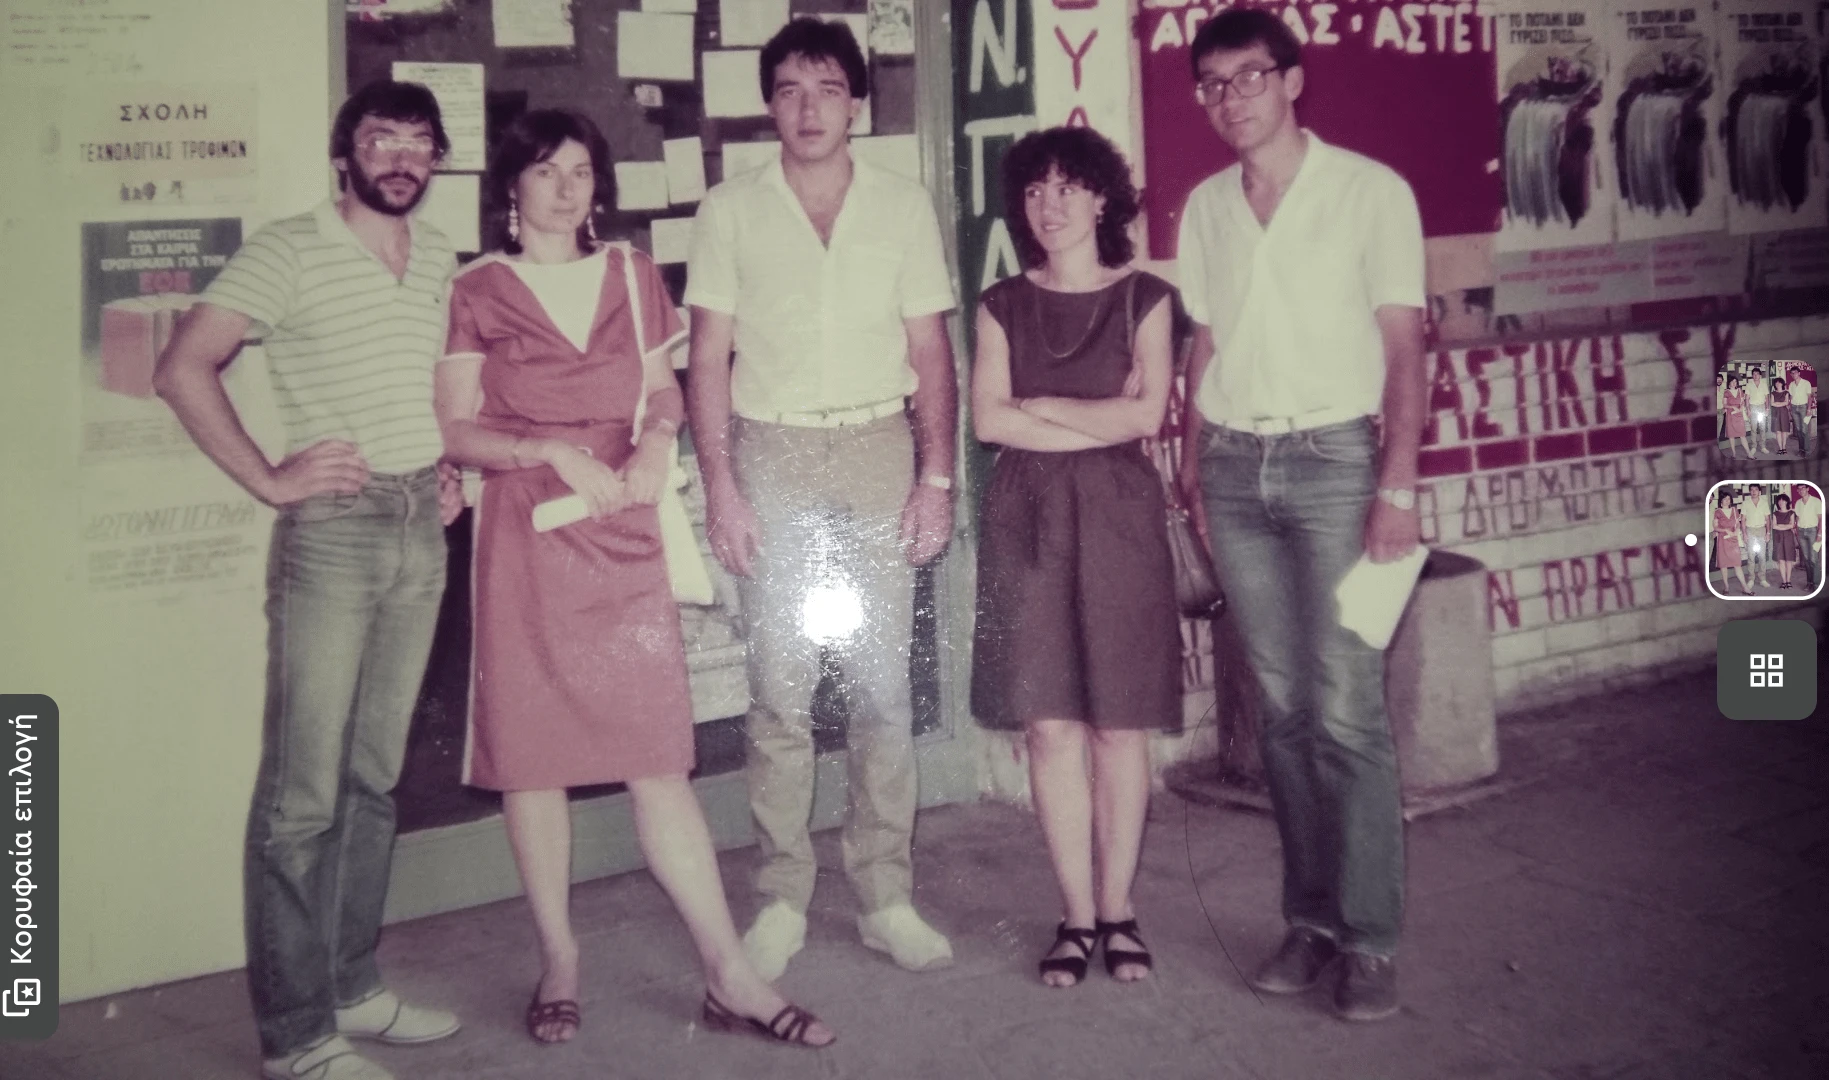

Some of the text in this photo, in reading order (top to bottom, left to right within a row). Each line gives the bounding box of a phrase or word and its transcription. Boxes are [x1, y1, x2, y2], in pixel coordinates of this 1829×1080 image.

[119, 103, 208, 122] ΣΧΟΛΗ
[79, 139, 247, 163] ΤΕΧΝΟΛΟΓΙΑΣ ΤΡΟΦΙΜΩΝ
